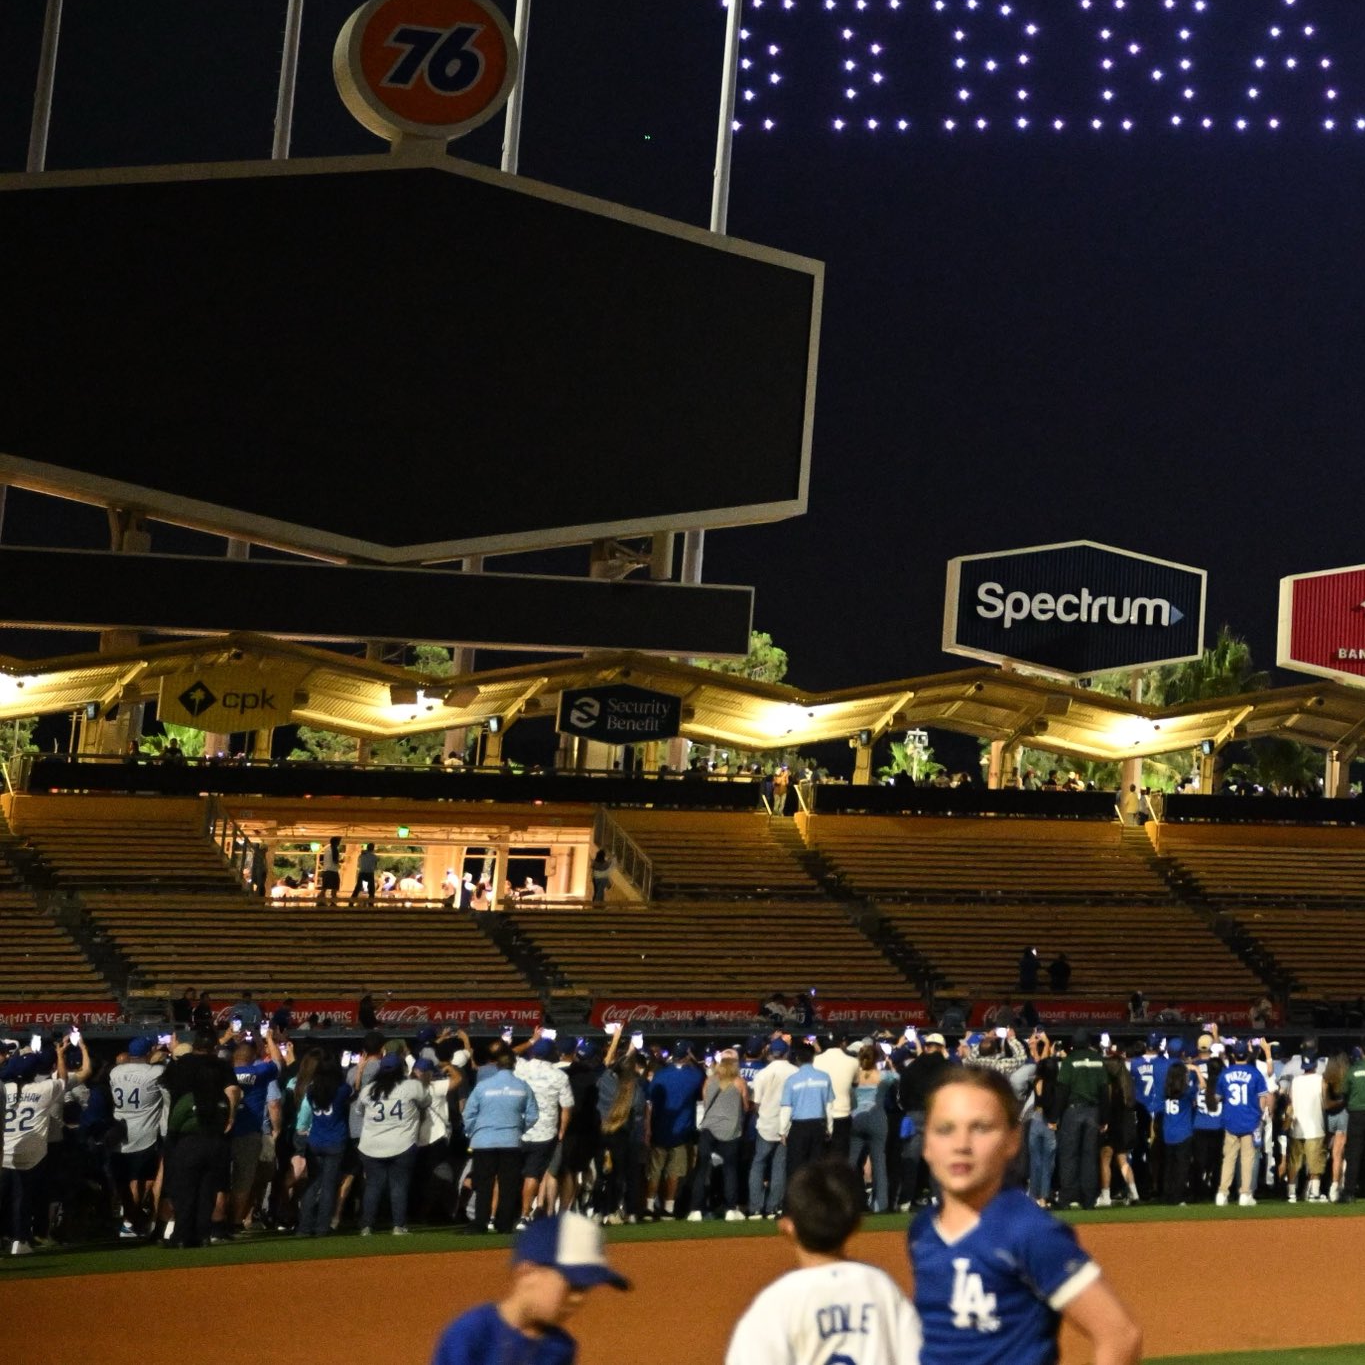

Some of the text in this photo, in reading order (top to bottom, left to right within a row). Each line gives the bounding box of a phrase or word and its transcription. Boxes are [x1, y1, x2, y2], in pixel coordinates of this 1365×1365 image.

[380, 22, 486, 96] 76
[976, 581, 1171, 629] Spectrum
[222, 688, 275, 715] cpk
[607, 697, 671, 717] Security
[607, 715, 662, 732] Benefit
[13, 1013, 33, 1023] HIT
[36, 1013, 81, 1023] EVERY
[83, 1013, 116, 1023] TIME
[374, 1005, 540, 1021] oca-Cola A HIT EVERY TIME
[860, 1010, 896, 1020] EVERY
[899, 1010, 924, 1020] TIME
[1069, 1011, 1089, 1019] RUN
[1091, 1011, 1121, 1020] MAGIC
[1141, 1075, 1154, 1097] 7
[1228, 1083, 1249, 1106] 31
[115, 1088, 141, 1110] 34
[1165, 1099, 1180, 1115] 16
[4, 1108, 36, 1133] 22
[373, 1100, 404, 1122] 34
[949, 1257, 1001, 1331] LA
[817, 1303, 876, 1340] COLE
